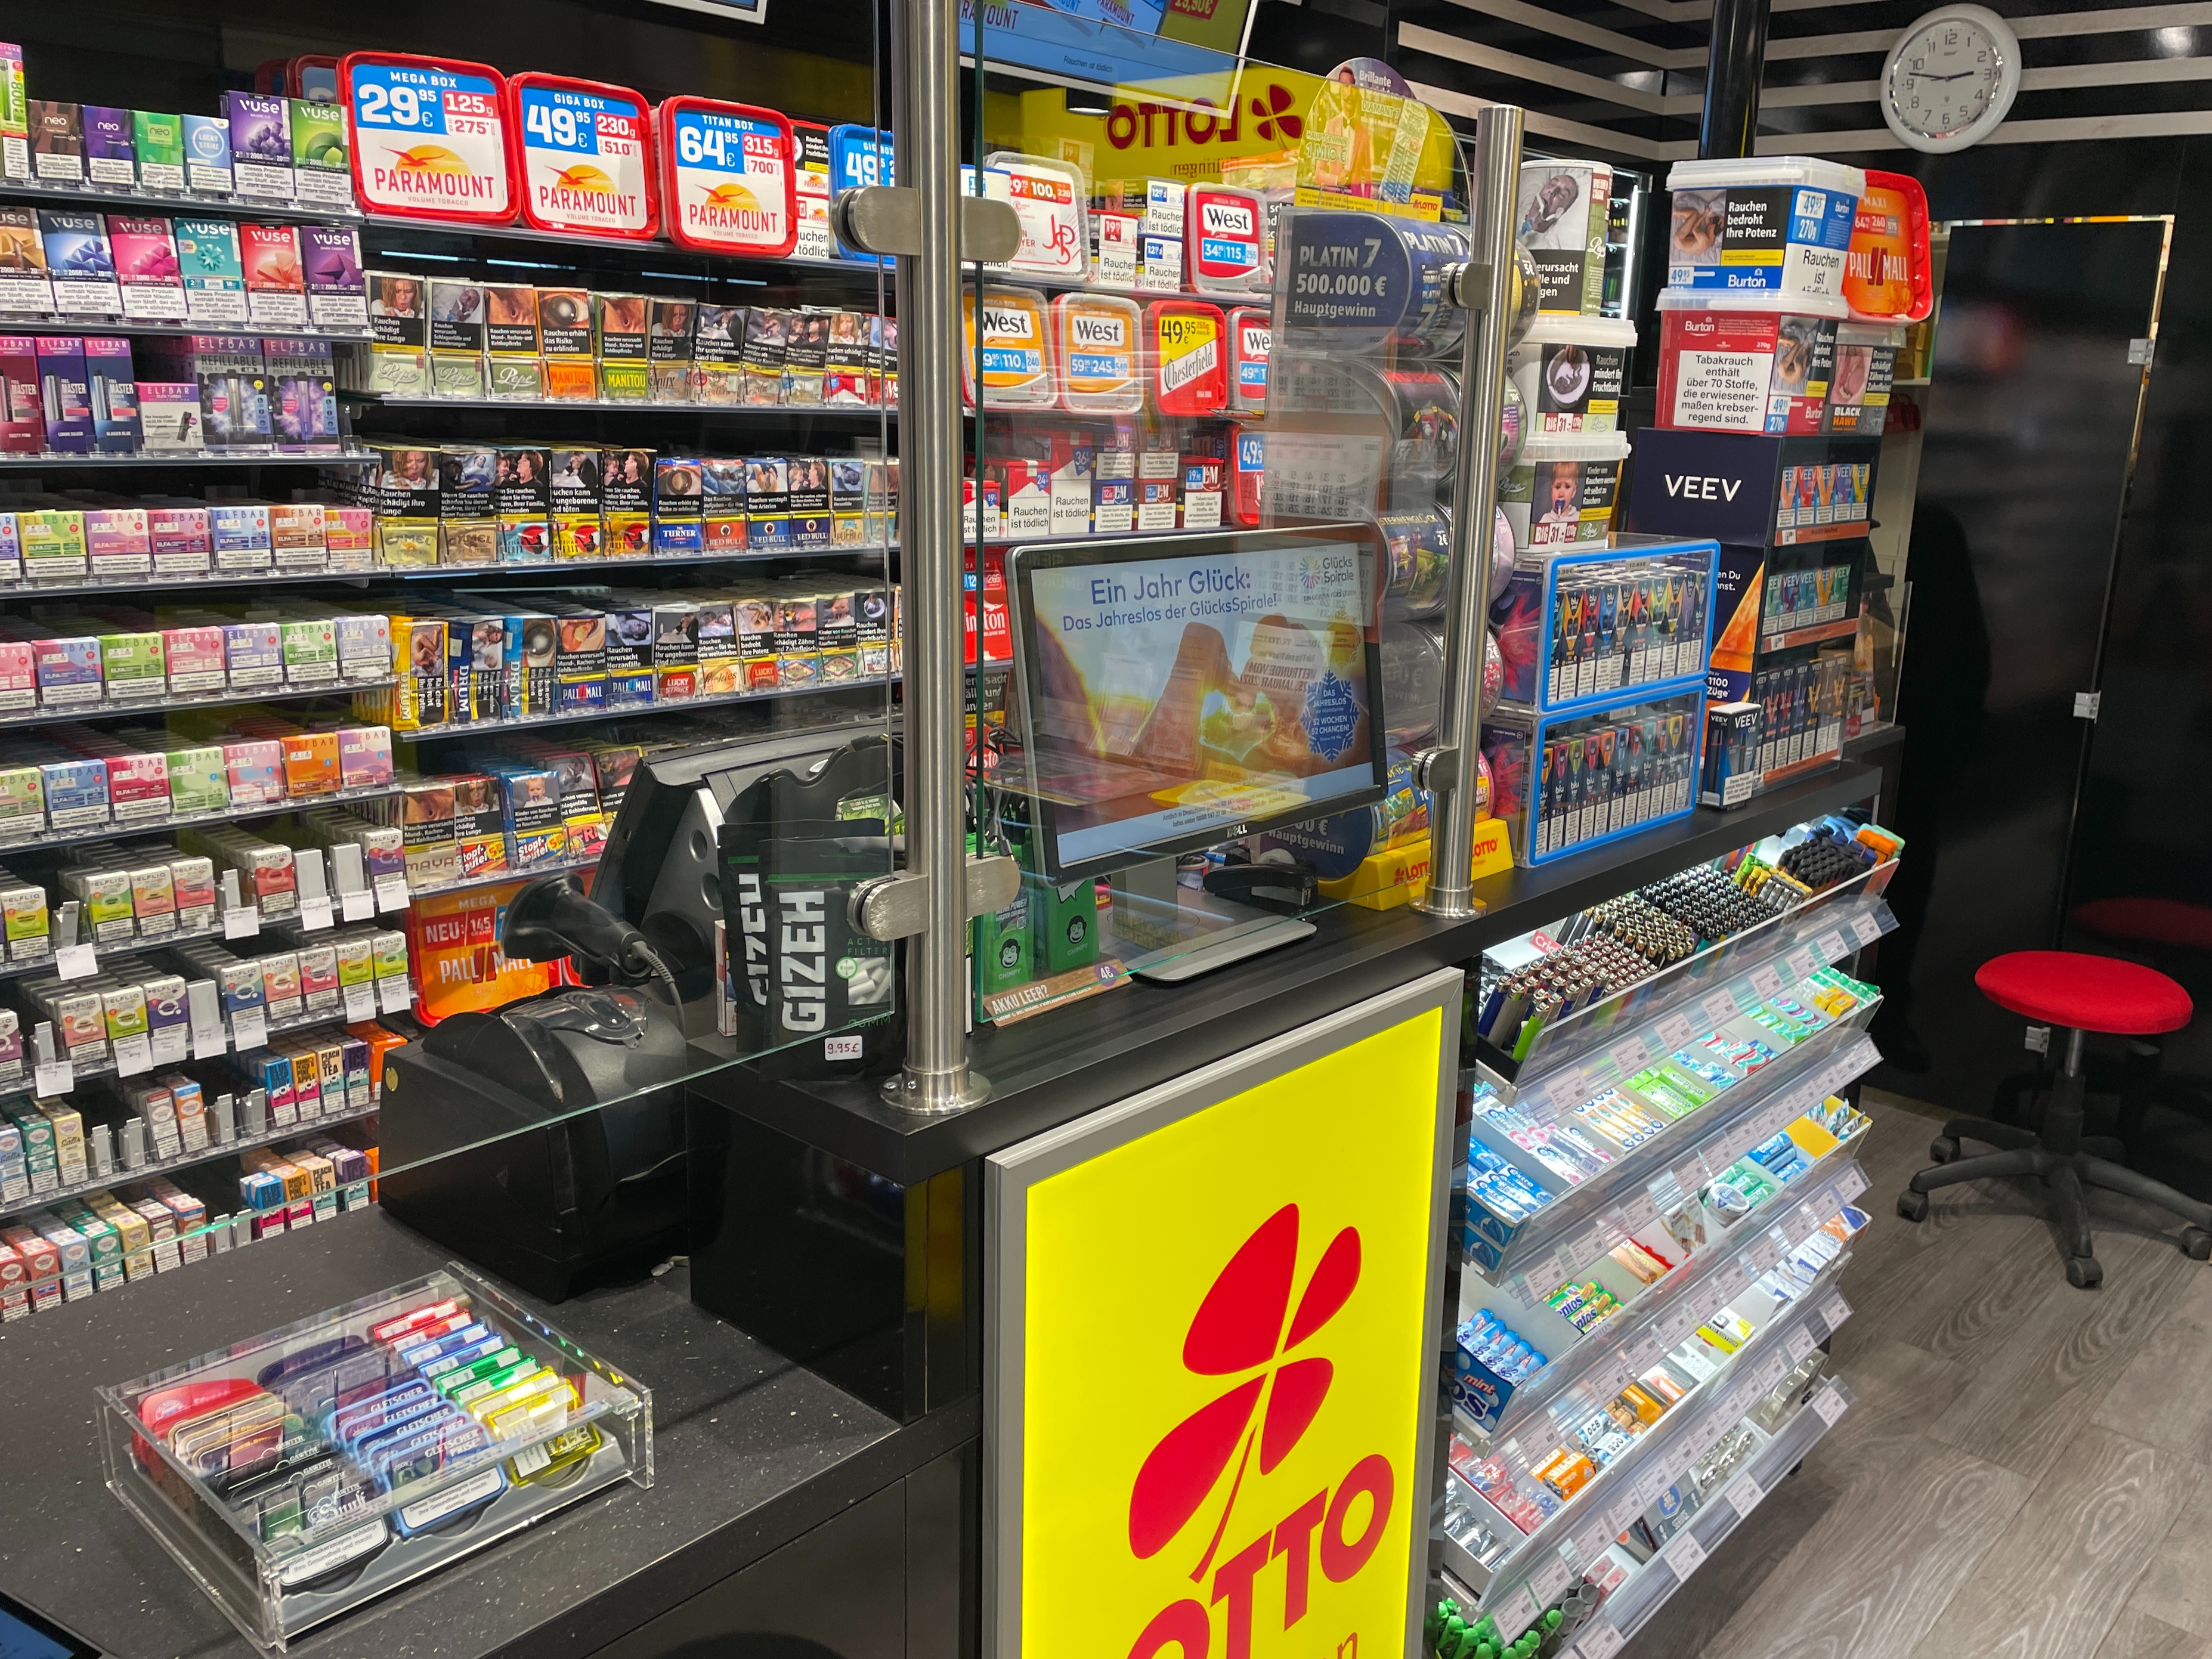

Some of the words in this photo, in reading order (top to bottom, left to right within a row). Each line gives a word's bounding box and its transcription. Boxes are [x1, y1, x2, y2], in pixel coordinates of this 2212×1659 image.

[1945, 33, 1957, 45] 12
[1928, 42, 1935, 53] 11
[1064, 55, 1087, 68] Rauchen
[1978, 51, 1986, 63] 2
[1913, 58, 1925, 70] 10
[390, 72, 426, 85] MEGA
[431, 76, 456, 88] BOX
[1359, 70, 1391, 87] Brillante
[1984, 69, 1991, 80] 3
[1907, 79, 1914, 89] 9
[1975, 89, 1983, 100] 4
[358, 85, 419, 125] 29
[555, 94, 580, 106] GIGA
[584, 98, 605, 110] BOX
[1911, 96, 1919, 109] 8
[1362, 100, 1393, 119] DIAMANT
[1924, 110, 1932, 121] 7
[1960, 106, 1968, 117] 5
[45, 116, 66, 126] neo
[527, 104, 576, 146] 49
[703, 114, 731, 129] TITAN
[735, 119, 754, 131] BOX
[1942, 113, 1950, 125] 6
[98, 121, 119, 132] neo
[197, 134, 219, 143] LUCKY
[199, 141, 220, 150] STRIKE
[680, 126, 724, 166] 64
[375, 168, 494, 199] PARAMOUNT
[407, 196, 436, 205] VOLUME
[540, 186, 636, 217] PARAMOUNT
[1729, 201, 1766, 212] Rauchen
[1836, 200, 1849, 213] Burton
[1864, 196, 1886, 208] MAXI
[567, 213, 592, 221] VOLUME
[689, 204, 777, 233] PARAMOUNT
[1207, 208, 1248, 230] West
[1728, 214, 1763, 225] bedroht
[1727, 227, 1744, 239] Ihre
[1746, 227, 1777, 239] Potenz
[1403, 231, 1452, 255] PLATIN
[1300, 246, 1358, 267] PLATIN
[1803, 249, 1839, 268] Rauchen
[1849, 252, 1873, 279] PALL
[1883, 255, 1908, 281] MALL
[1728, 274, 1766, 288] Burton
[1814, 270, 1826, 285] ist
[1297, 274, 1370, 295] 500.000
[1375, 276, 1387, 296] €
[1295, 301, 1376, 318] Hauptgewinn
[545, 329, 567, 338] Rauchen
[1076, 320, 1119, 342] West
[1685, 321, 1715, 333] Burton
[202, 355, 257, 367] REFILLABLE
[273, 357, 326, 369] REFILLABLE
[1163, 343, 1213, 392] Chesterfield
[1696, 355, 1753, 367] Tabakrauch
[1706, 367, 1740, 377] enthält
[61, 383, 86, 395] MASTER
[109, 383, 134, 395] MASTER
[1687, 377, 1709, 389] über
[1711, 378, 1722, 389] 70
[1724, 379, 1758, 391] Stoffe,
[1684, 389, 1697, 400] die
[1700, 391, 1759, 403] erwiesener-
[1681, 400, 1713, 411] maßen
[1715, 402, 1758, 414] krebser-
[1834, 407, 1861, 417] BLACK
[1545, 414, 1557, 431] BIG
[1688, 413, 1721, 425] regend
[1723, 413, 1749, 424] sind.
[1833, 417, 1857, 426] HAWK
[1665, 474, 1741, 502] VEEV
[1056, 497, 1088, 505] Rauchen
[1014, 507, 1047, 516] Rauchen
[1024, 519, 1048, 528] tödlich
[385, 534, 431, 546] CAMEL
[450, 533, 492, 547] CAMEL
[663, 530, 695, 538] TURNER
[1323, 557, 1353, 570] Glücks
[1323, 570, 1354, 585] Spirale
[1090, 578, 1125, 605] Ein
[1134, 572, 1181, 601] Jahr
[1188, 567, 1251, 595] Glück:
[1062, 615, 1092, 632] Das
[1096, 608, 1161, 627] Jahreslos
[1165, 605, 1186, 620] der
[1190, 593, 1277, 618] GlücksSpirale!
[510, 661, 520, 707] DRUM
[667, 677, 688, 686] LUCKY
[1709, 677, 1728, 687] 1100
[459, 665, 469, 712] DRUM
[586, 685, 602, 698] MALL
[666, 685, 689, 694] STRIKE
[1313, 698, 1347, 707] JAHRESLOS
[1320, 716, 1347, 725] WOCHEN
[1735, 713, 1757, 728] VEEV
[459, 895, 497, 910] MEGA
[471, 917, 491, 930] 145
[426, 921, 465, 943] NEU:
[779, 891, 825, 1032] GIZEH
[440, 955, 479, 984] PALL
[998, 968, 1021, 980] CHIMPY
[991, 992, 1020, 1014] AKKU
[1020, 985, 1049, 1005] LEER?
[321, 1050, 339, 1060] PEACH
[1463, 1373, 1496, 1396] mint
[370, 1386, 423, 1413] GLETSCHER
[396, 1407, 450, 1435] GLETSCHER
[1587, 1419, 1601, 1435] OCB
[425, 1429, 479, 1458] GLETSCHER
